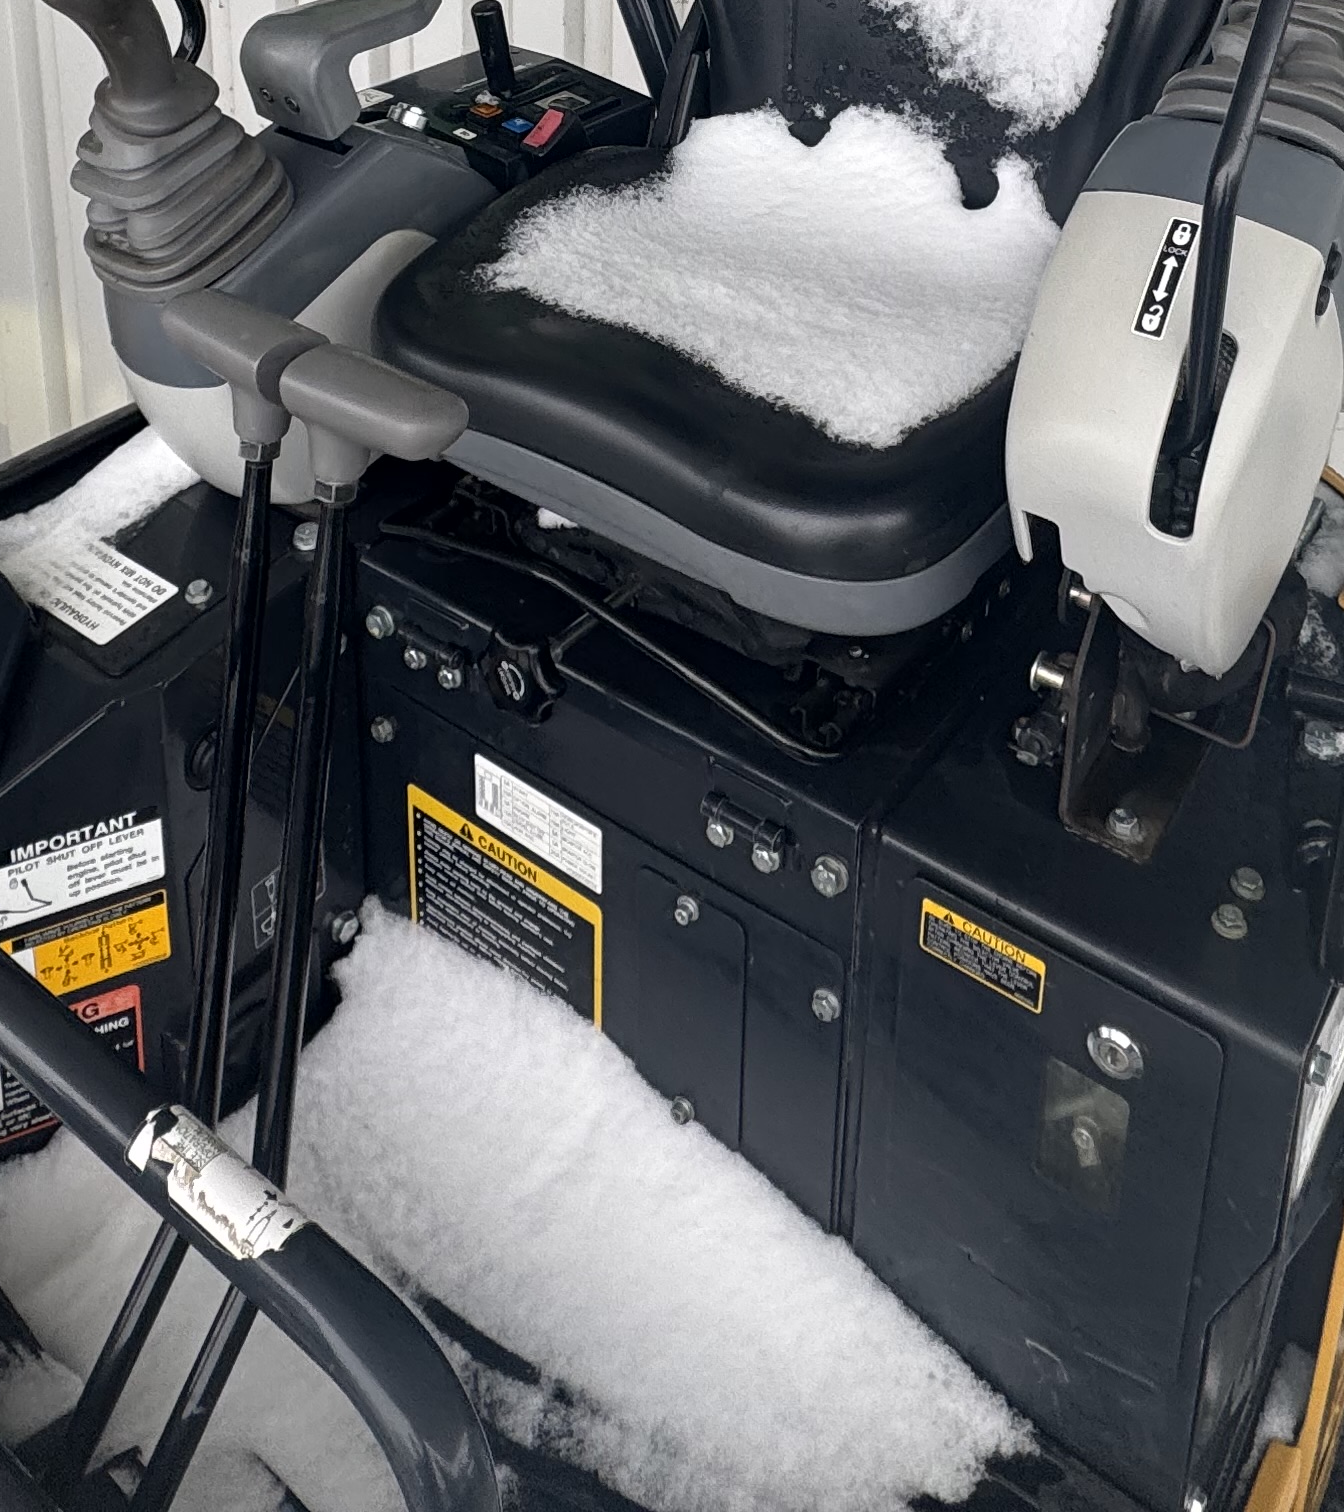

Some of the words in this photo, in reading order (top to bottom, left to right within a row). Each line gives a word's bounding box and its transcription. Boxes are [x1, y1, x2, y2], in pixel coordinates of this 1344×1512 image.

[1163, 245, 1188, 257] LOCK
[8, 861, 41, 877] PILOT
[46, 850, 76, 865] SHUT
[81, 840, 103, 854] OFF
[109, 828, 144, 845] LEVER
[10, 811, 137, 864] IMPORTANT
[478, 835, 537, 883] CAUTION
[962, 921, 1027, 963] CAUTION
